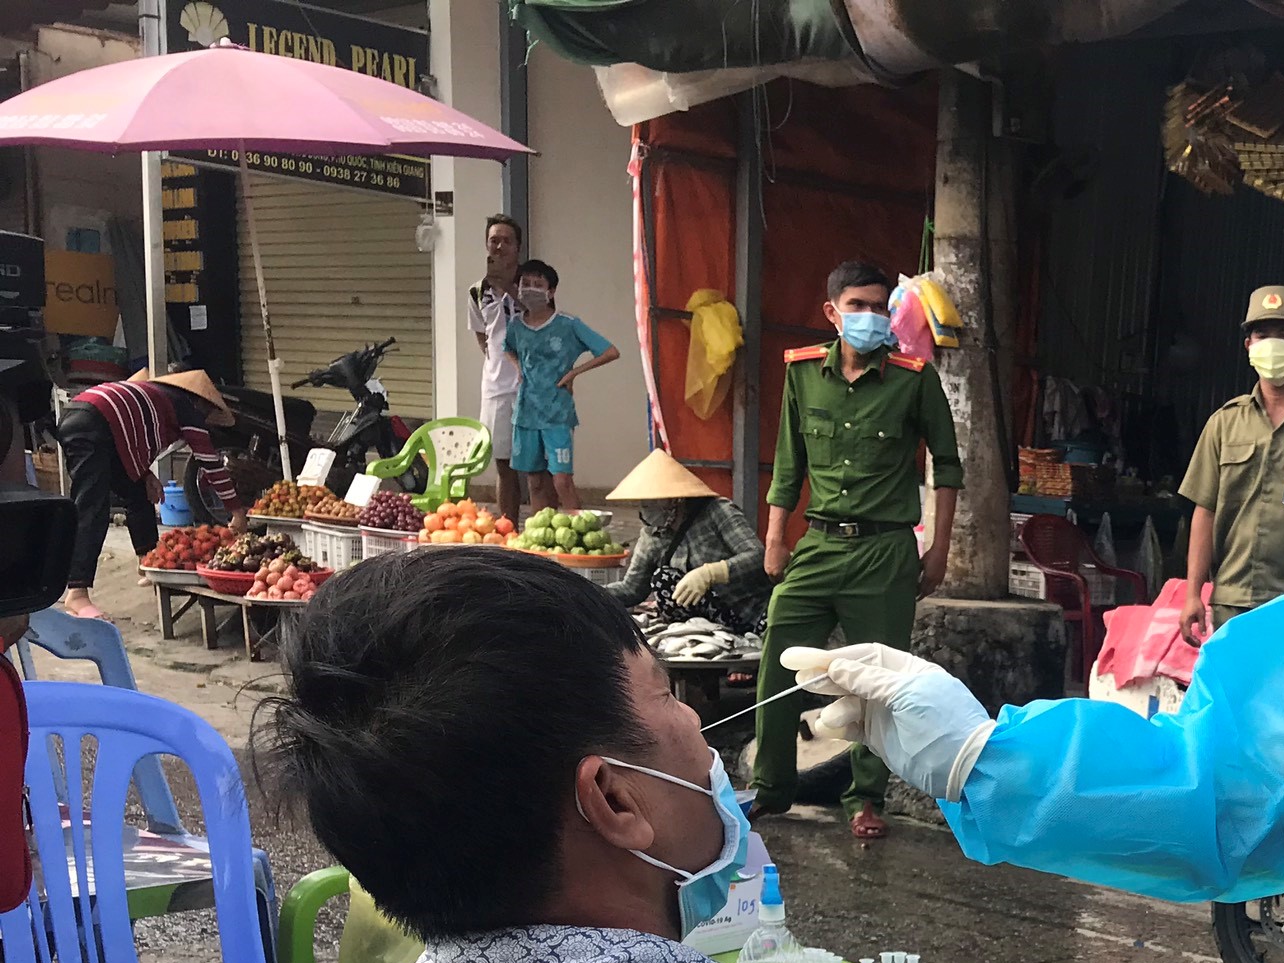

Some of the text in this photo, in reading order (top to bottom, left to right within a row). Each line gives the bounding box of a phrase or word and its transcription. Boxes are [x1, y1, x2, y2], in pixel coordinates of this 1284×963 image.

[231, 151, 260, 165] 036
[263, 155, 278, 168] 90
[281, 157, 296, 171] 80
[298, 160, 313, 174] 90
[323, 164, 351, 180] 0938
[353, 171, 366, 182] 27
[555, 447, 571, 464] 10
